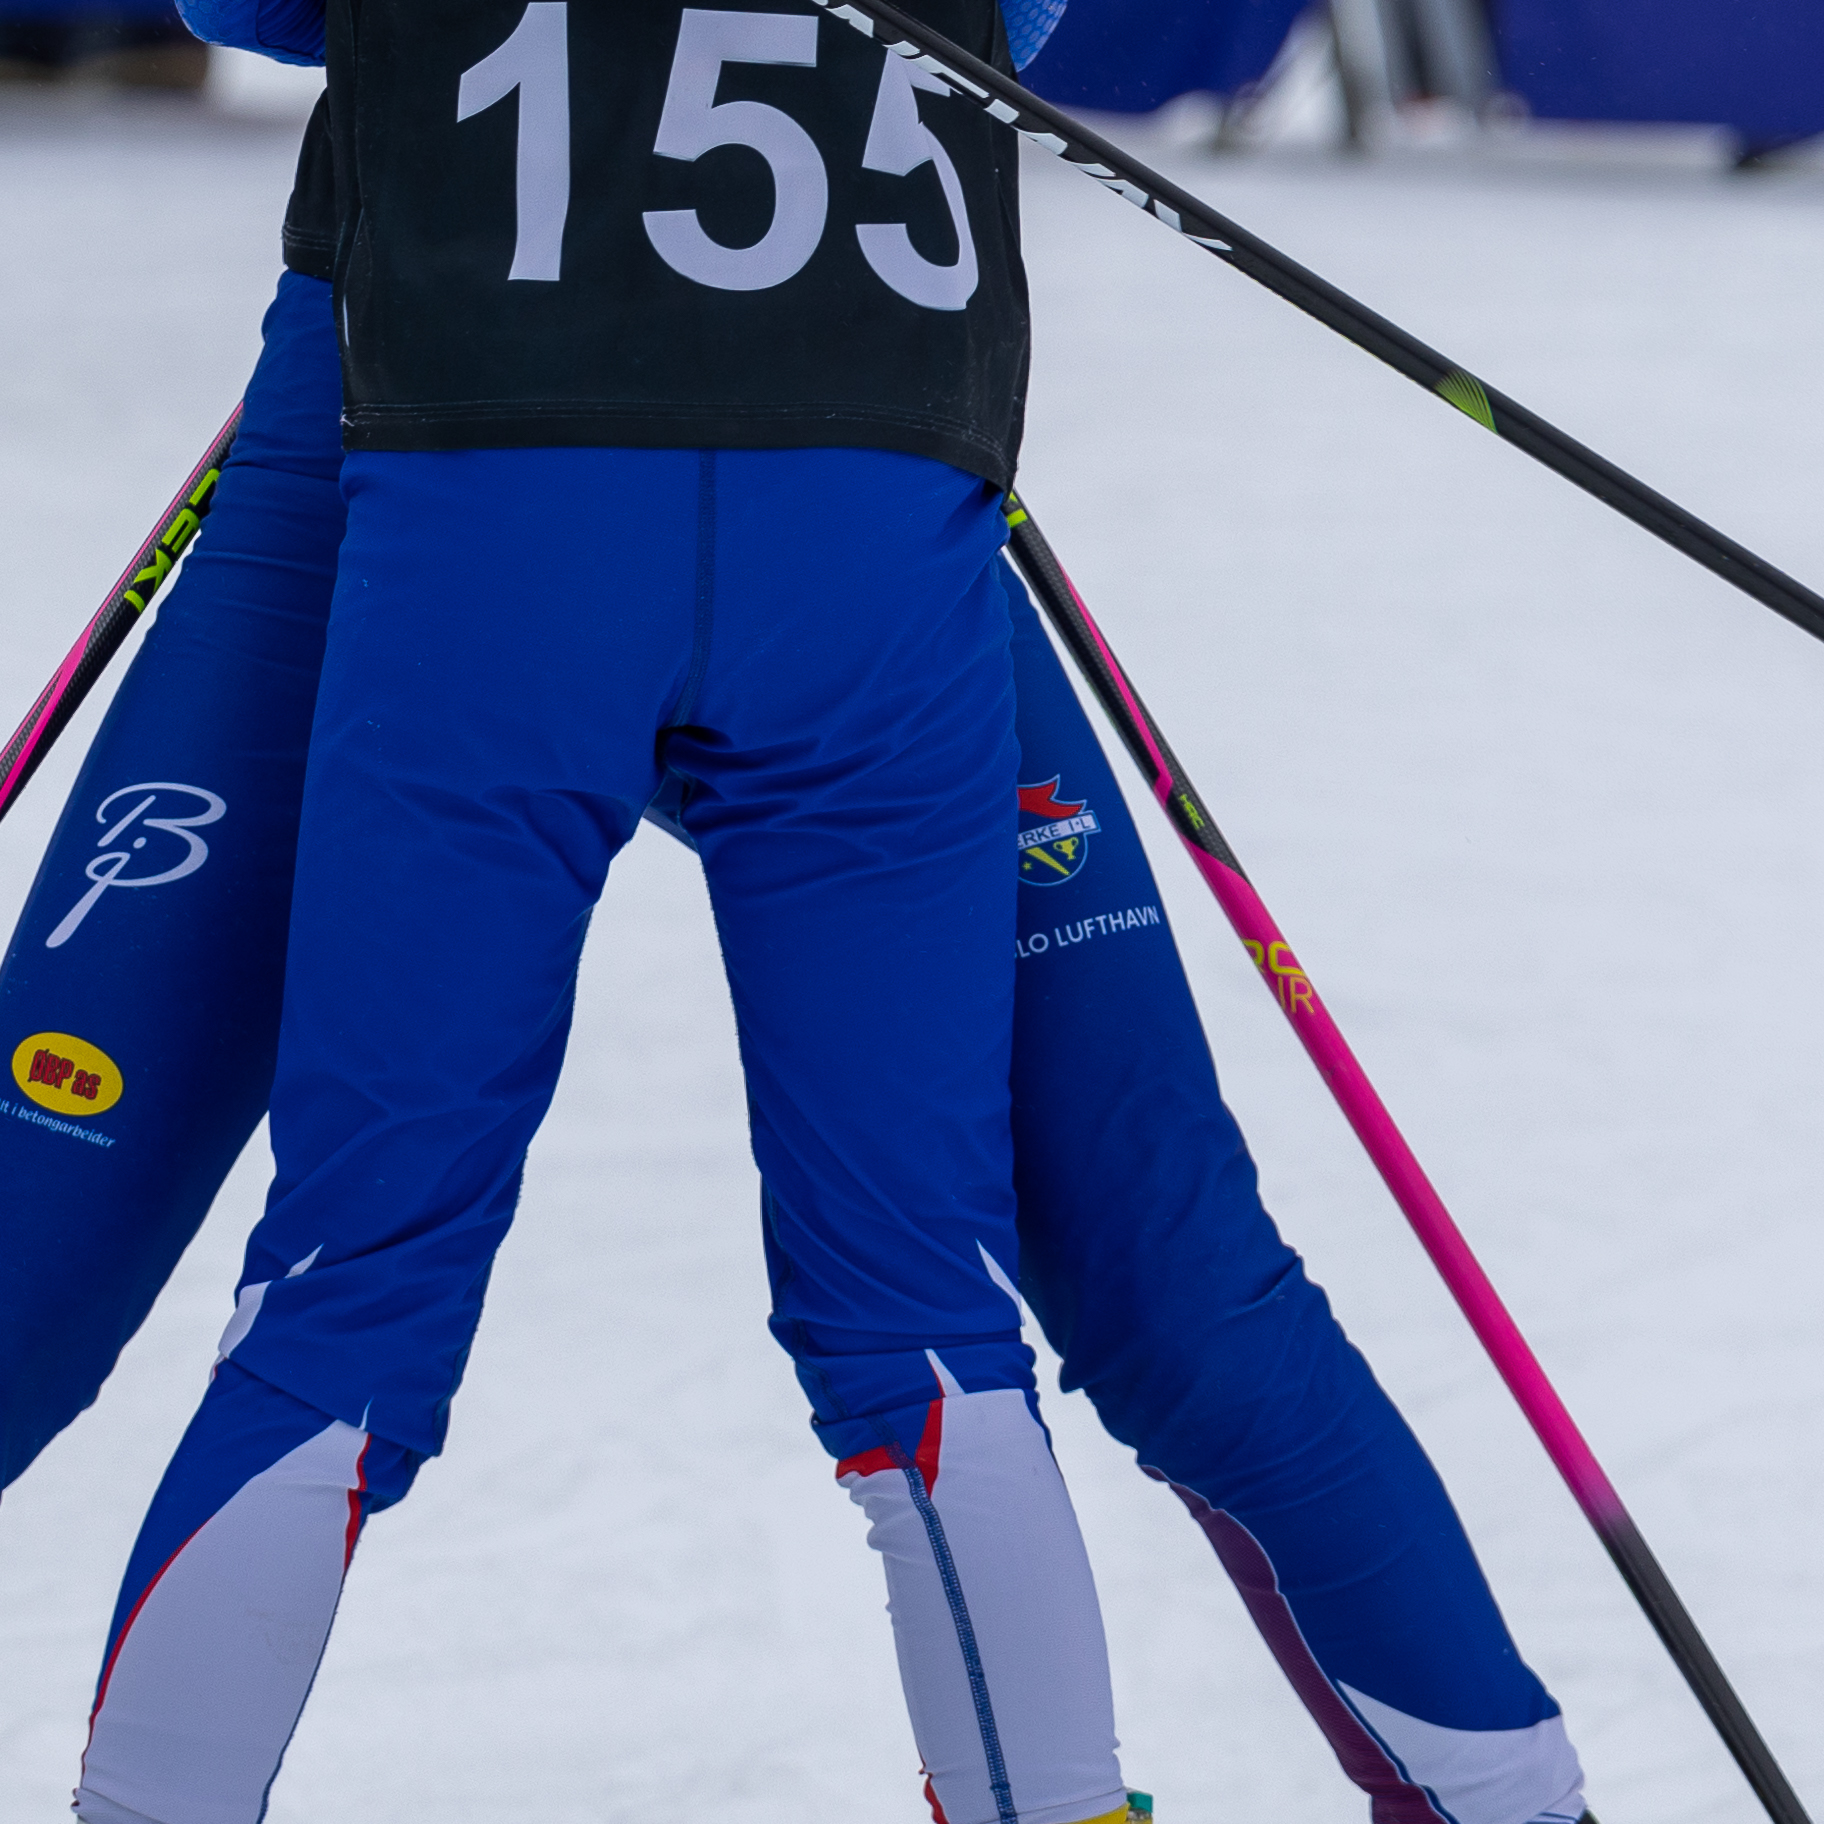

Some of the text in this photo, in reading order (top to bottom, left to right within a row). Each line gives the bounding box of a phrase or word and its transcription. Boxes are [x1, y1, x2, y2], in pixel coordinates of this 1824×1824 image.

[456, 0, 979, 312] 155
[1055, 905, 1161, 948] LUFTHAVN
[27, 1048, 102, 1101] ØBP as
[17, 1105, 116, 1148] betongarbeider
